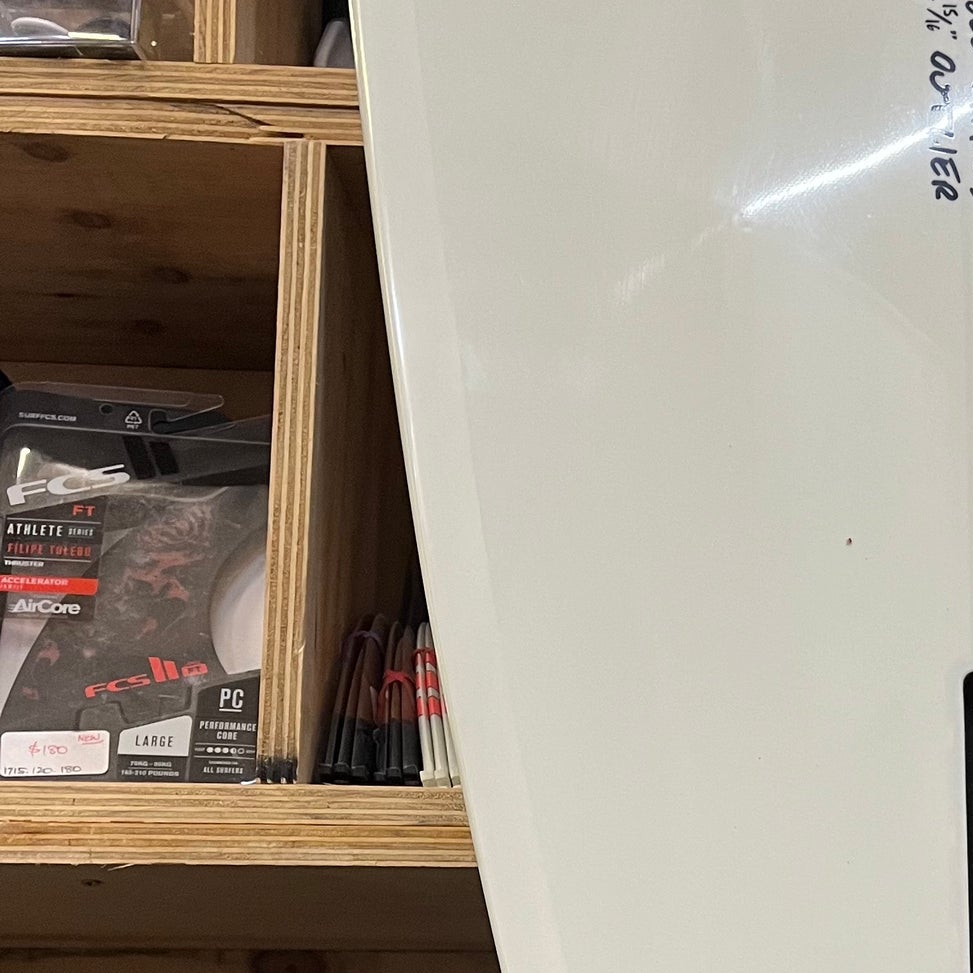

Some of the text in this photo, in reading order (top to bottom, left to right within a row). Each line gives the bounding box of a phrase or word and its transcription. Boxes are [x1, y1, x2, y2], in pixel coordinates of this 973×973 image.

[929, 50, 962, 201] OUIER
[6, 463, 131, 506] FCS
[72, 504, 96, 517] FT
[7, 523, 94, 537] ATHLETE SERIES
[7, 542, 92, 557] FILIPE TOLEDO
[4, 559, 44, 567] THRUSTER
[0, 576, 69, 586] ACCELERATOR
[9, 599, 81, 615] AirCore
[84, 673, 151, 698] FCS
[219, 688, 244, 709] PC
[199, 720, 257, 732] PERFORMANCE
[78, 733, 101, 741] NEW
[135, 735, 174, 748] LARGE
[216, 731, 238, 741] CORE
[29, 741, 68, 757] $180
